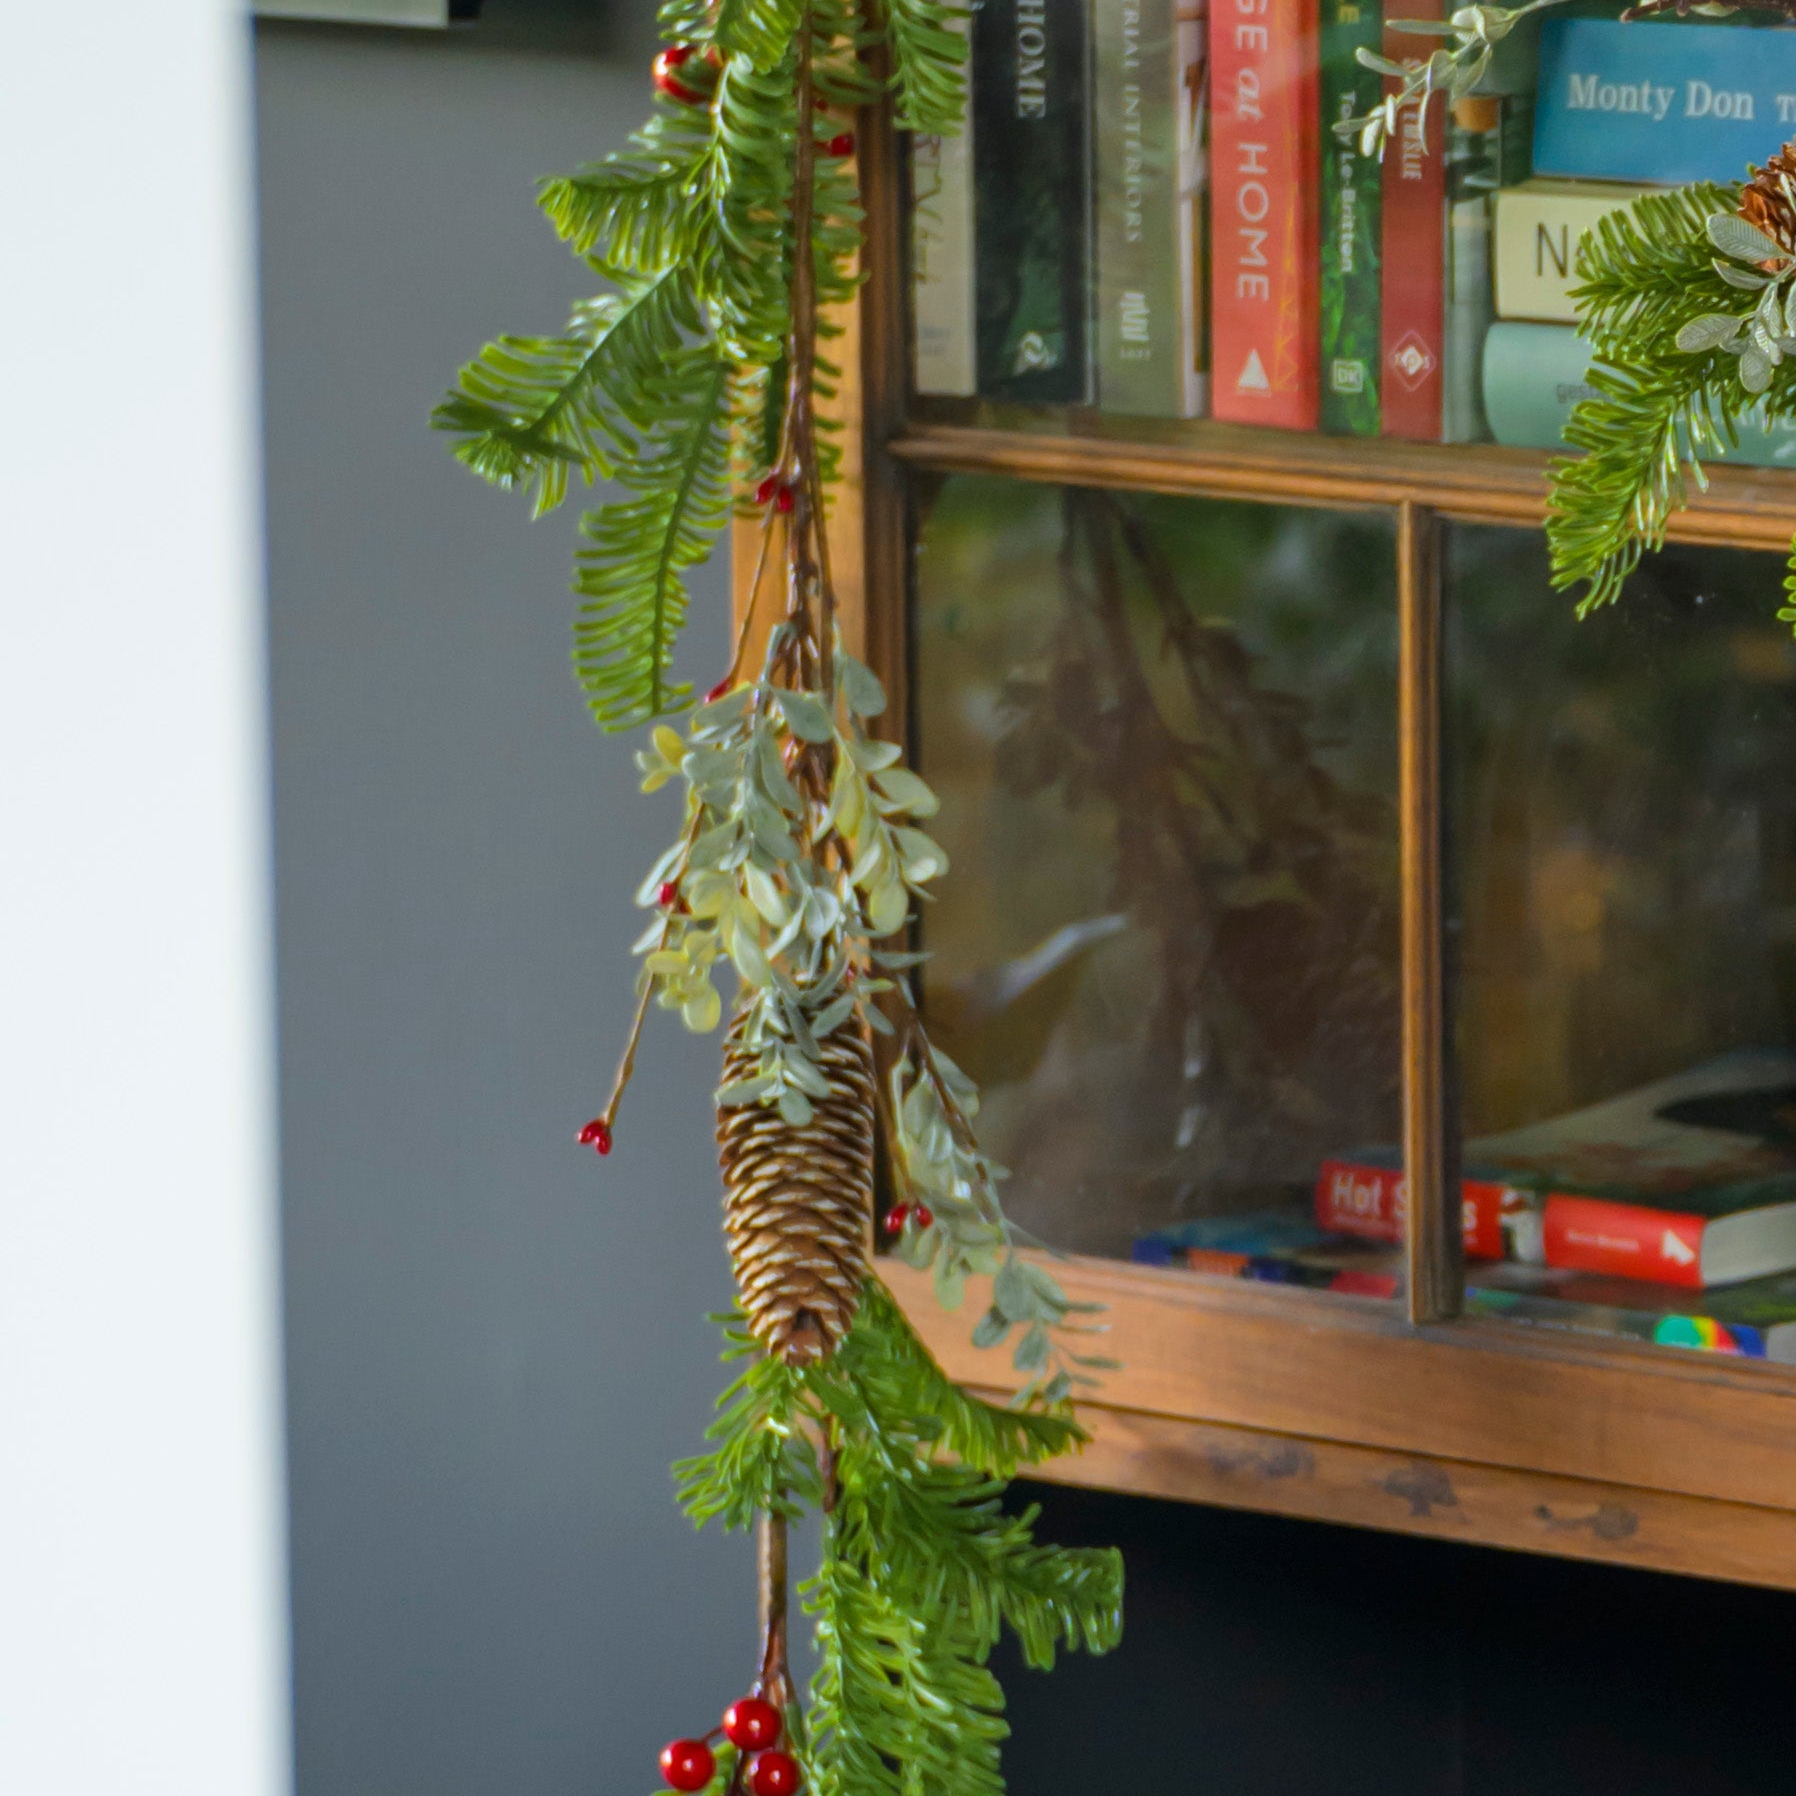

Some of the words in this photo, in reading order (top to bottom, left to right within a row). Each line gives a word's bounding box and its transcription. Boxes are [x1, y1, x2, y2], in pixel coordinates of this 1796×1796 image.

[1236, 67, 1262, 123] at
[1566, 72, 1677, 122] Monty
[1684, 78, 1756, 121] Don
[1122, 84, 1144, 244] INTERIORS
[1237, 141, 1270, 302] HOME
[1331, 1169, 1383, 1218] Hot
